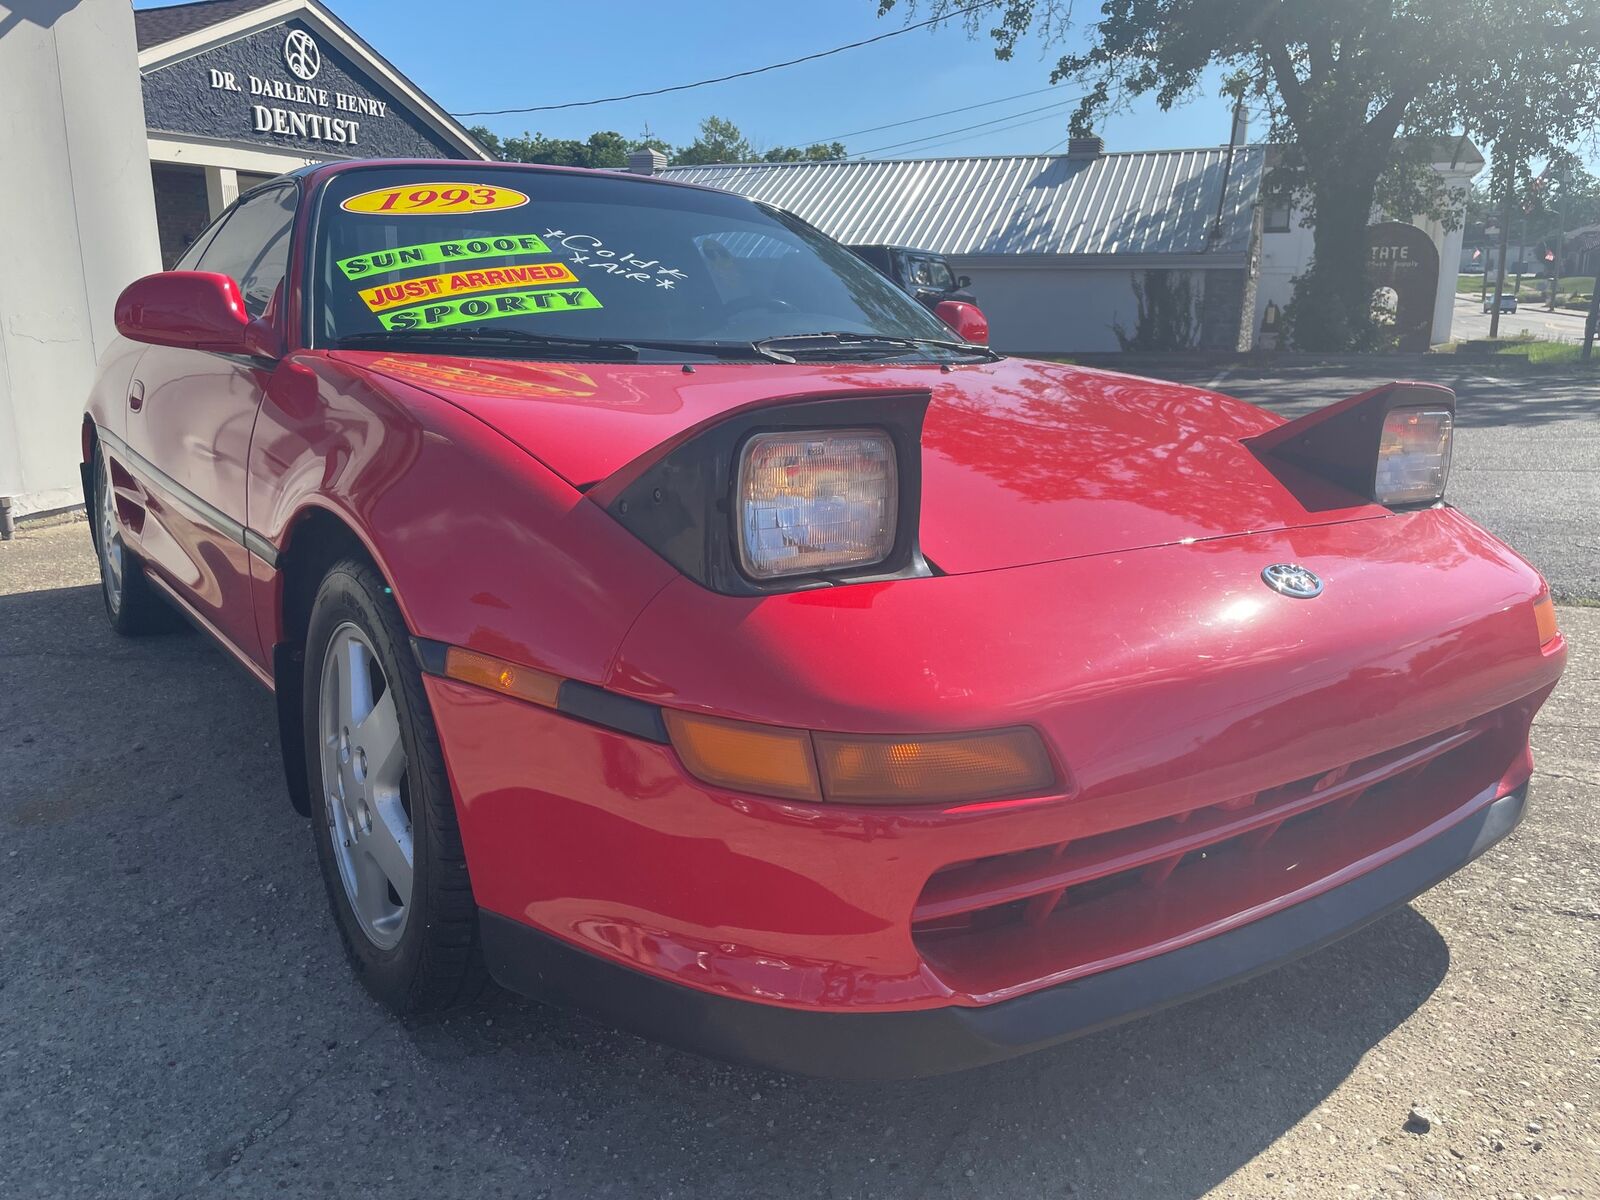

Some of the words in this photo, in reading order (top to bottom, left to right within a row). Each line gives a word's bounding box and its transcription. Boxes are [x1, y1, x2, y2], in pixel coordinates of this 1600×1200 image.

[211, 69, 241, 92] DR.
[250, 76, 329, 107] DARLENE
[336, 93, 386, 118] HENRY
[254, 105, 359, 145] DENTIST
[374, 188, 497, 211] 1993
[346, 248, 425, 275] SUN
[440, 236, 540, 258] ROOF
[369, 279, 441, 307] JUST
[450, 264, 567, 291] ARRIVED
[388, 291, 583, 330] SPORTY
